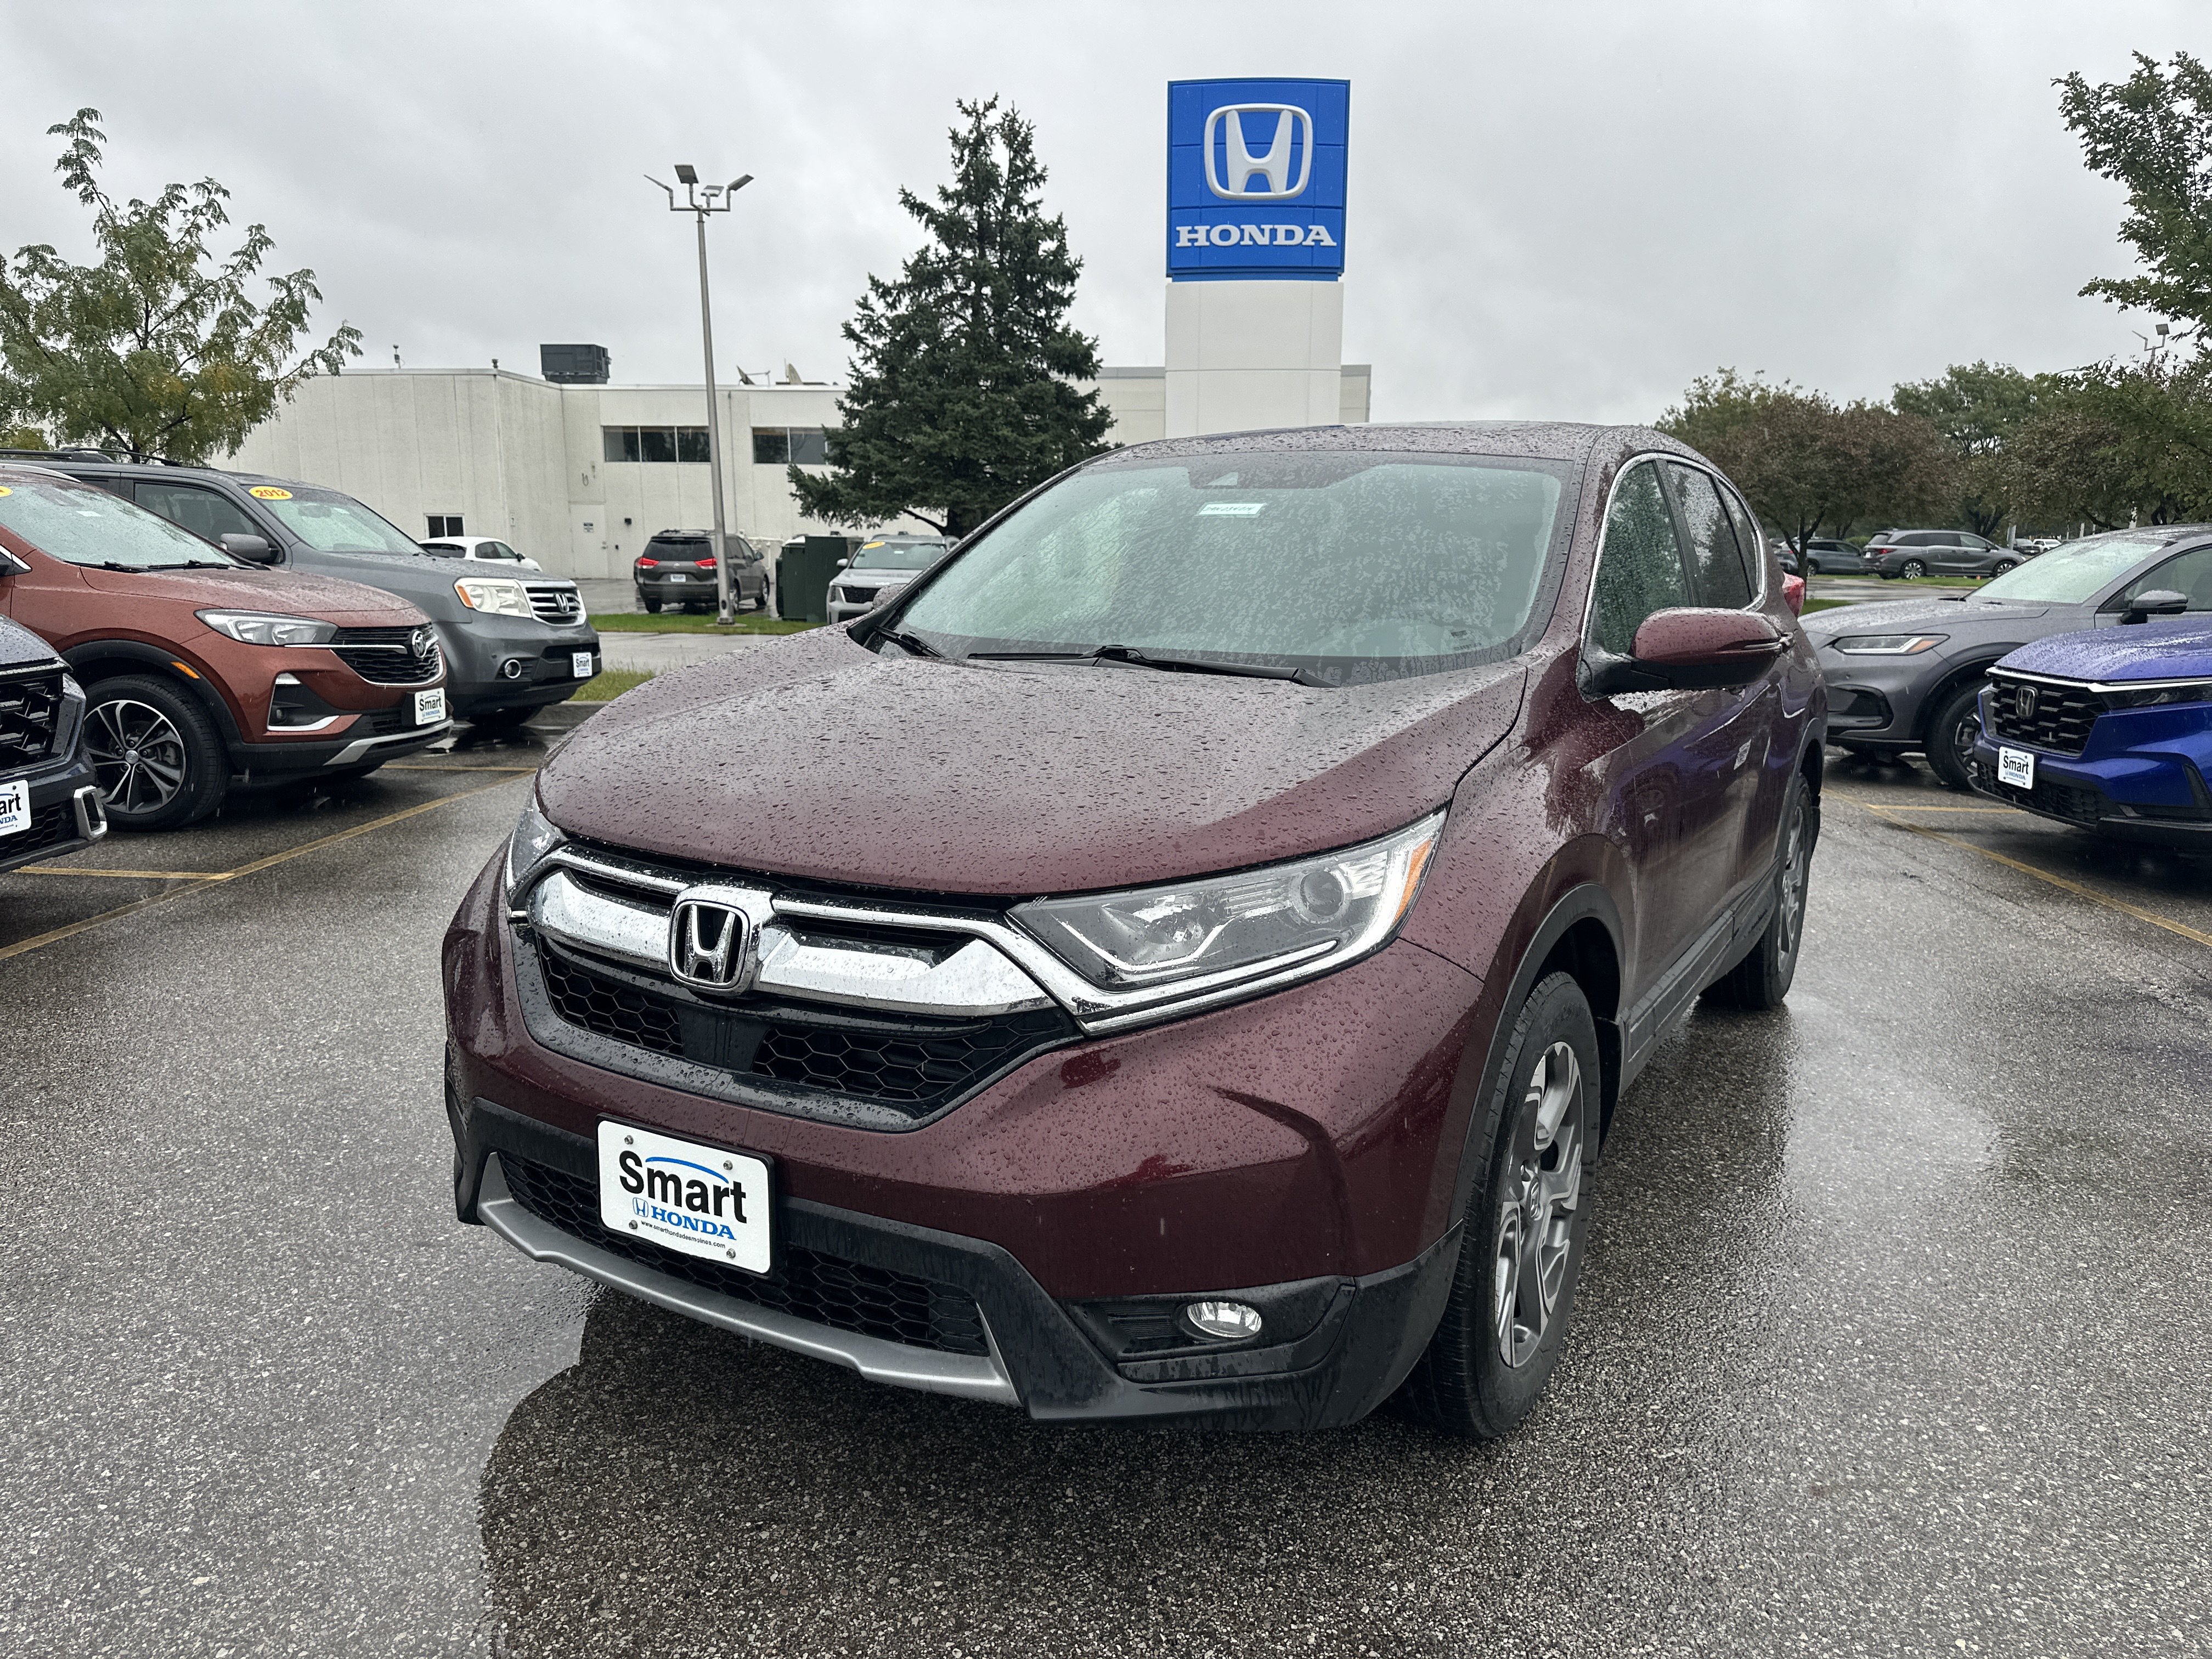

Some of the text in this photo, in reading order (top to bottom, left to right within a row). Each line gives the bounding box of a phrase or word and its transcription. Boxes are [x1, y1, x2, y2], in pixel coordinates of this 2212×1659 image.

[1176, 224, 1337, 246] HONDA
[419, 696, 442, 711] Smart
[2003, 755, 2029, 775] Smart
[0, 793, 21, 815] art
[0, 815, 18, 824] NDA
[619, 1150, 747, 1224] Smart
[651, 1205, 737, 1241] HONDA
[641, 1221, 725, 1248] www.smarthondadesmoines.com
